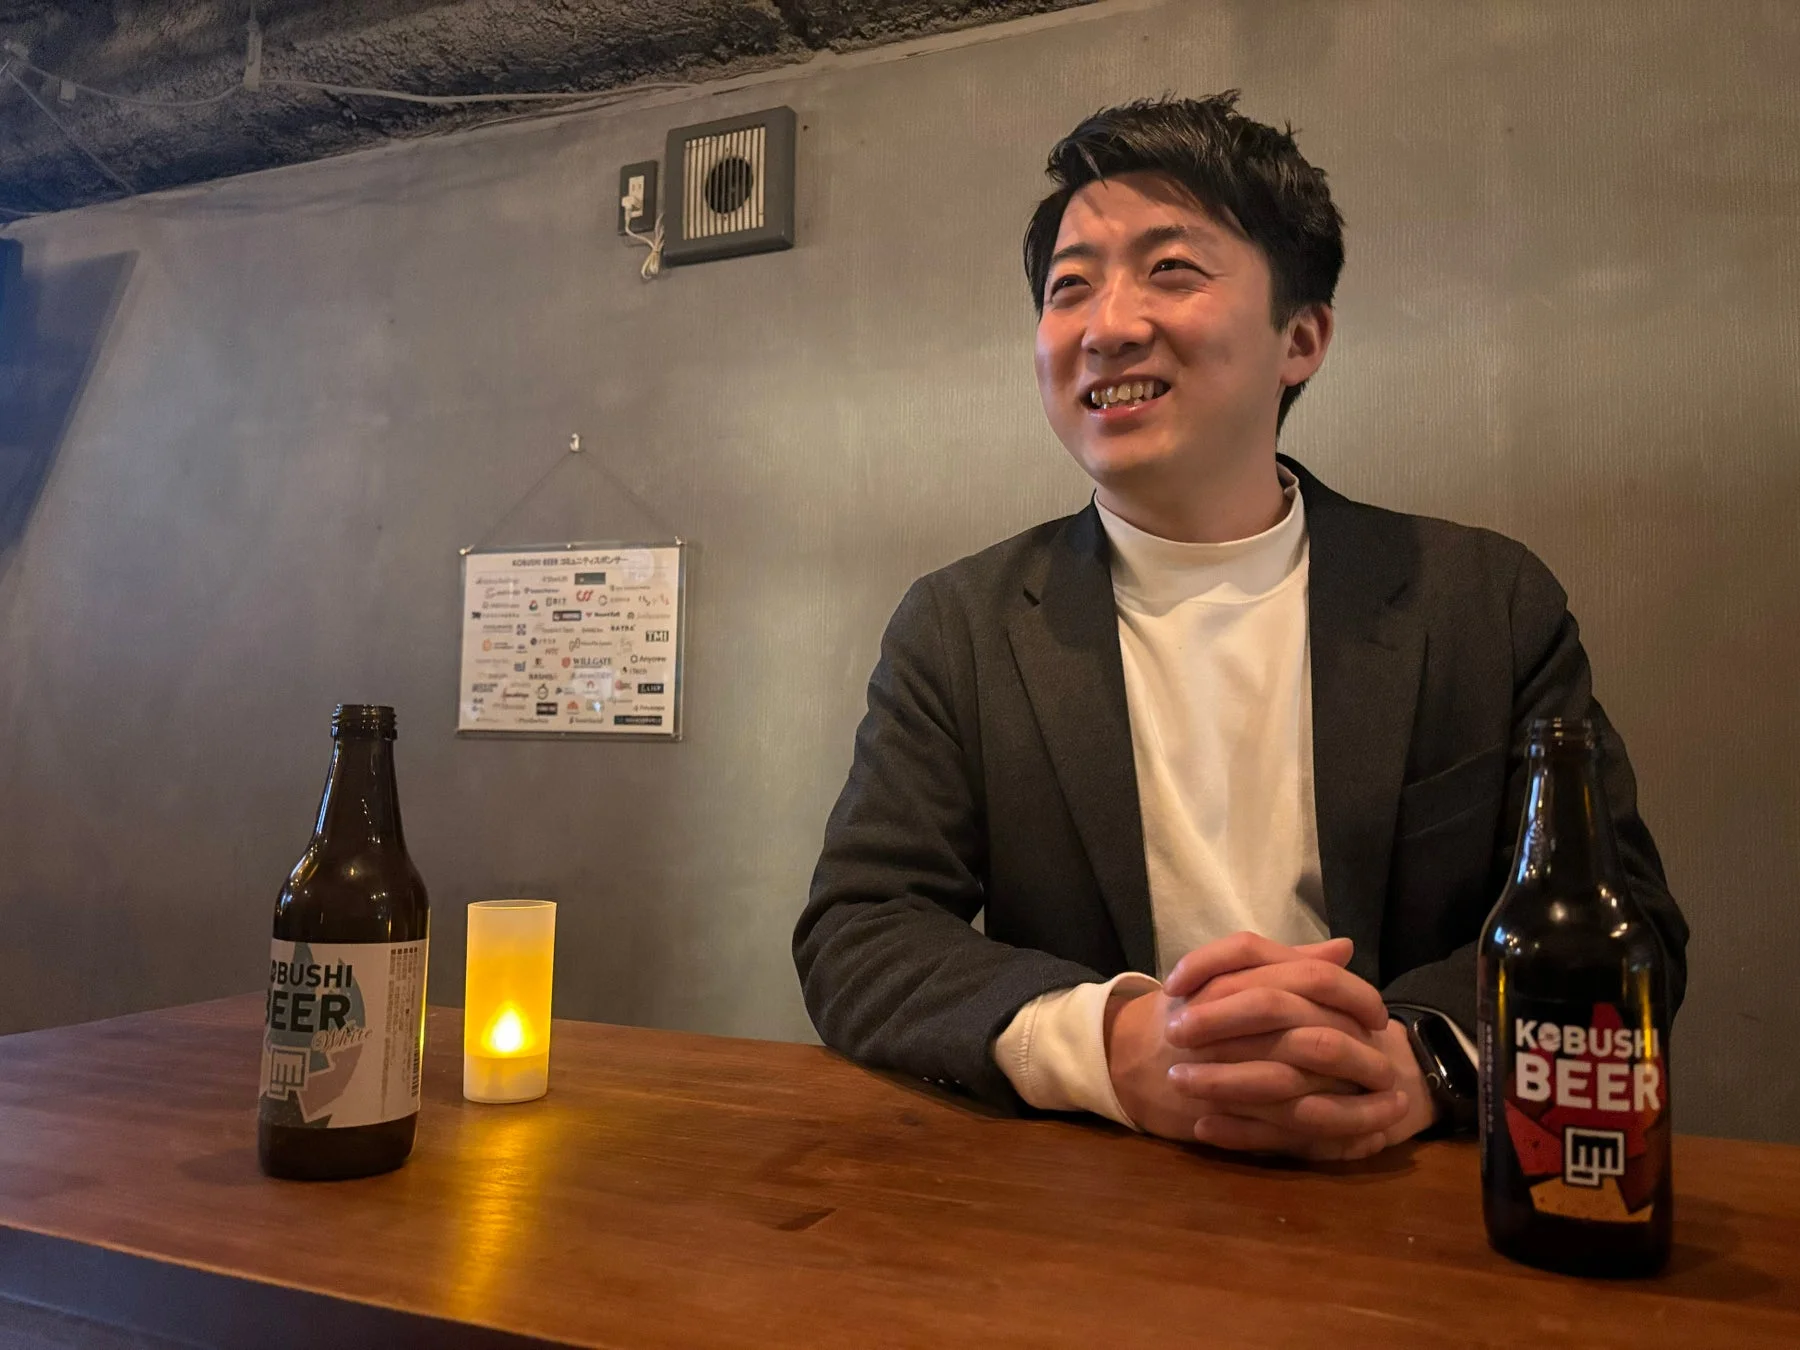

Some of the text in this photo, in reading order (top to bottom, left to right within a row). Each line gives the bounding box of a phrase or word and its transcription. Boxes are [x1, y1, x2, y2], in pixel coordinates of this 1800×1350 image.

[573, 657, 612, 665] WILLGATE
[1515, 1018, 1659, 1059] KOBUSHI
[1516, 1052, 1661, 1112] BEER
